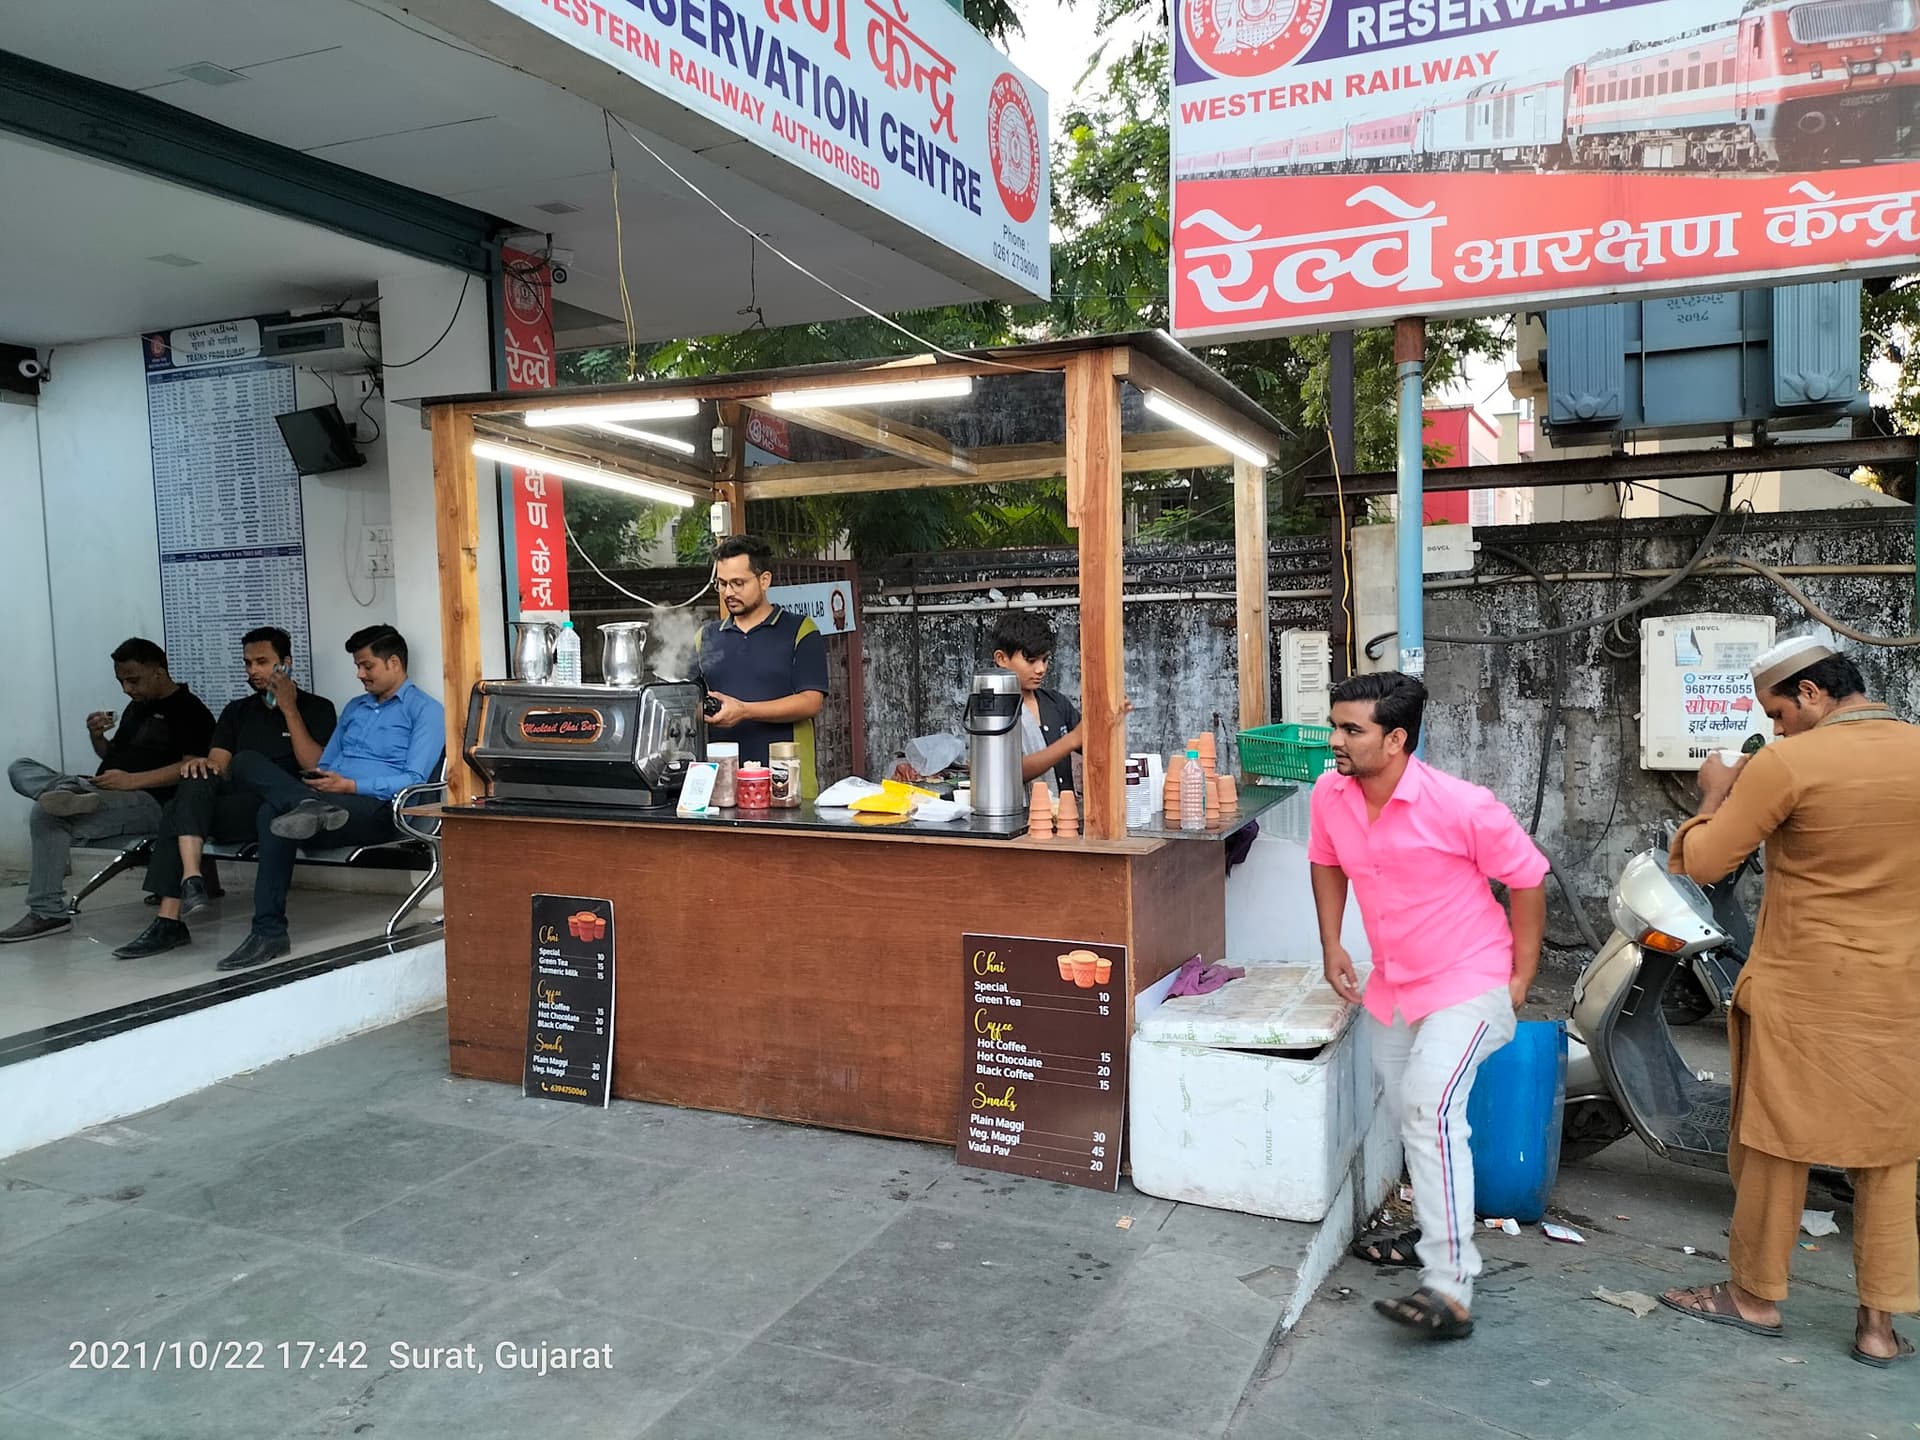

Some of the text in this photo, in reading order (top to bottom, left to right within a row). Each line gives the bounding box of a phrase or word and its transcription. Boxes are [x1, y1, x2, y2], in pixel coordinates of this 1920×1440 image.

[1180, 50, 1499, 124] WESTERN RAILWAY
[669, 48, 765, 127] RAILWAY
[772, 110, 880, 190] AUTHORISED
[880, 112, 982, 216] CENTRE
[1003, 224, 1025, 250] Phone
[1180, 180, 1920, 312] रेल्वे आरक्षण केन्द्र
[993, 241, 1010, 264] 0261
[505, 328, 551, 388] रेल्वे
[812, 601, 825, 617] LAB
[1685, 685, 1752, 694] 9687765055
[1685, 695, 1731, 714] सोफा
[539, 925, 559, 944] Chai
[539, 947, 605, 961] Special 10
[539, 956, 557, 965] Green
[557, 959, 568, 967] Tea
[973, 950, 1006, 976] Chai
[597, 972, 604, 980] 15
[974, 981, 1110, 1002] Special 10
[538, 1001, 604, 1016] Hot Coffee 15
[974, 994, 1109, 1016] Green Tea 15
[537, 1020, 603, 1035] Black Coffee 15
[538, 1011, 604, 1026] Hot Chocolate 20
[974, 1008, 1014, 1041] Coffee
[977, 1038, 1111, 1062] Hot Coffee 15
[533, 1055, 600, 1071] Plain Maggi 30
[547, 1067, 565, 1078] Maggi
[591, 1072, 600, 1081] 45
[976, 1051, 1110, 1076] Hot Chocolate 20
[976, 1064, 1110, 1090] Black Coffee 15
[971, 1082, 1017, 1111] Snacks
[970, 1113, 1106, 1143] Plain Maggi 30
[969, 1127, 1105, 1157] Veg. Maggi 45
[1264, 1128, 1272, 1166] FRAGILE
[967, 1141, 1103, 1172] Vada Pav 20
